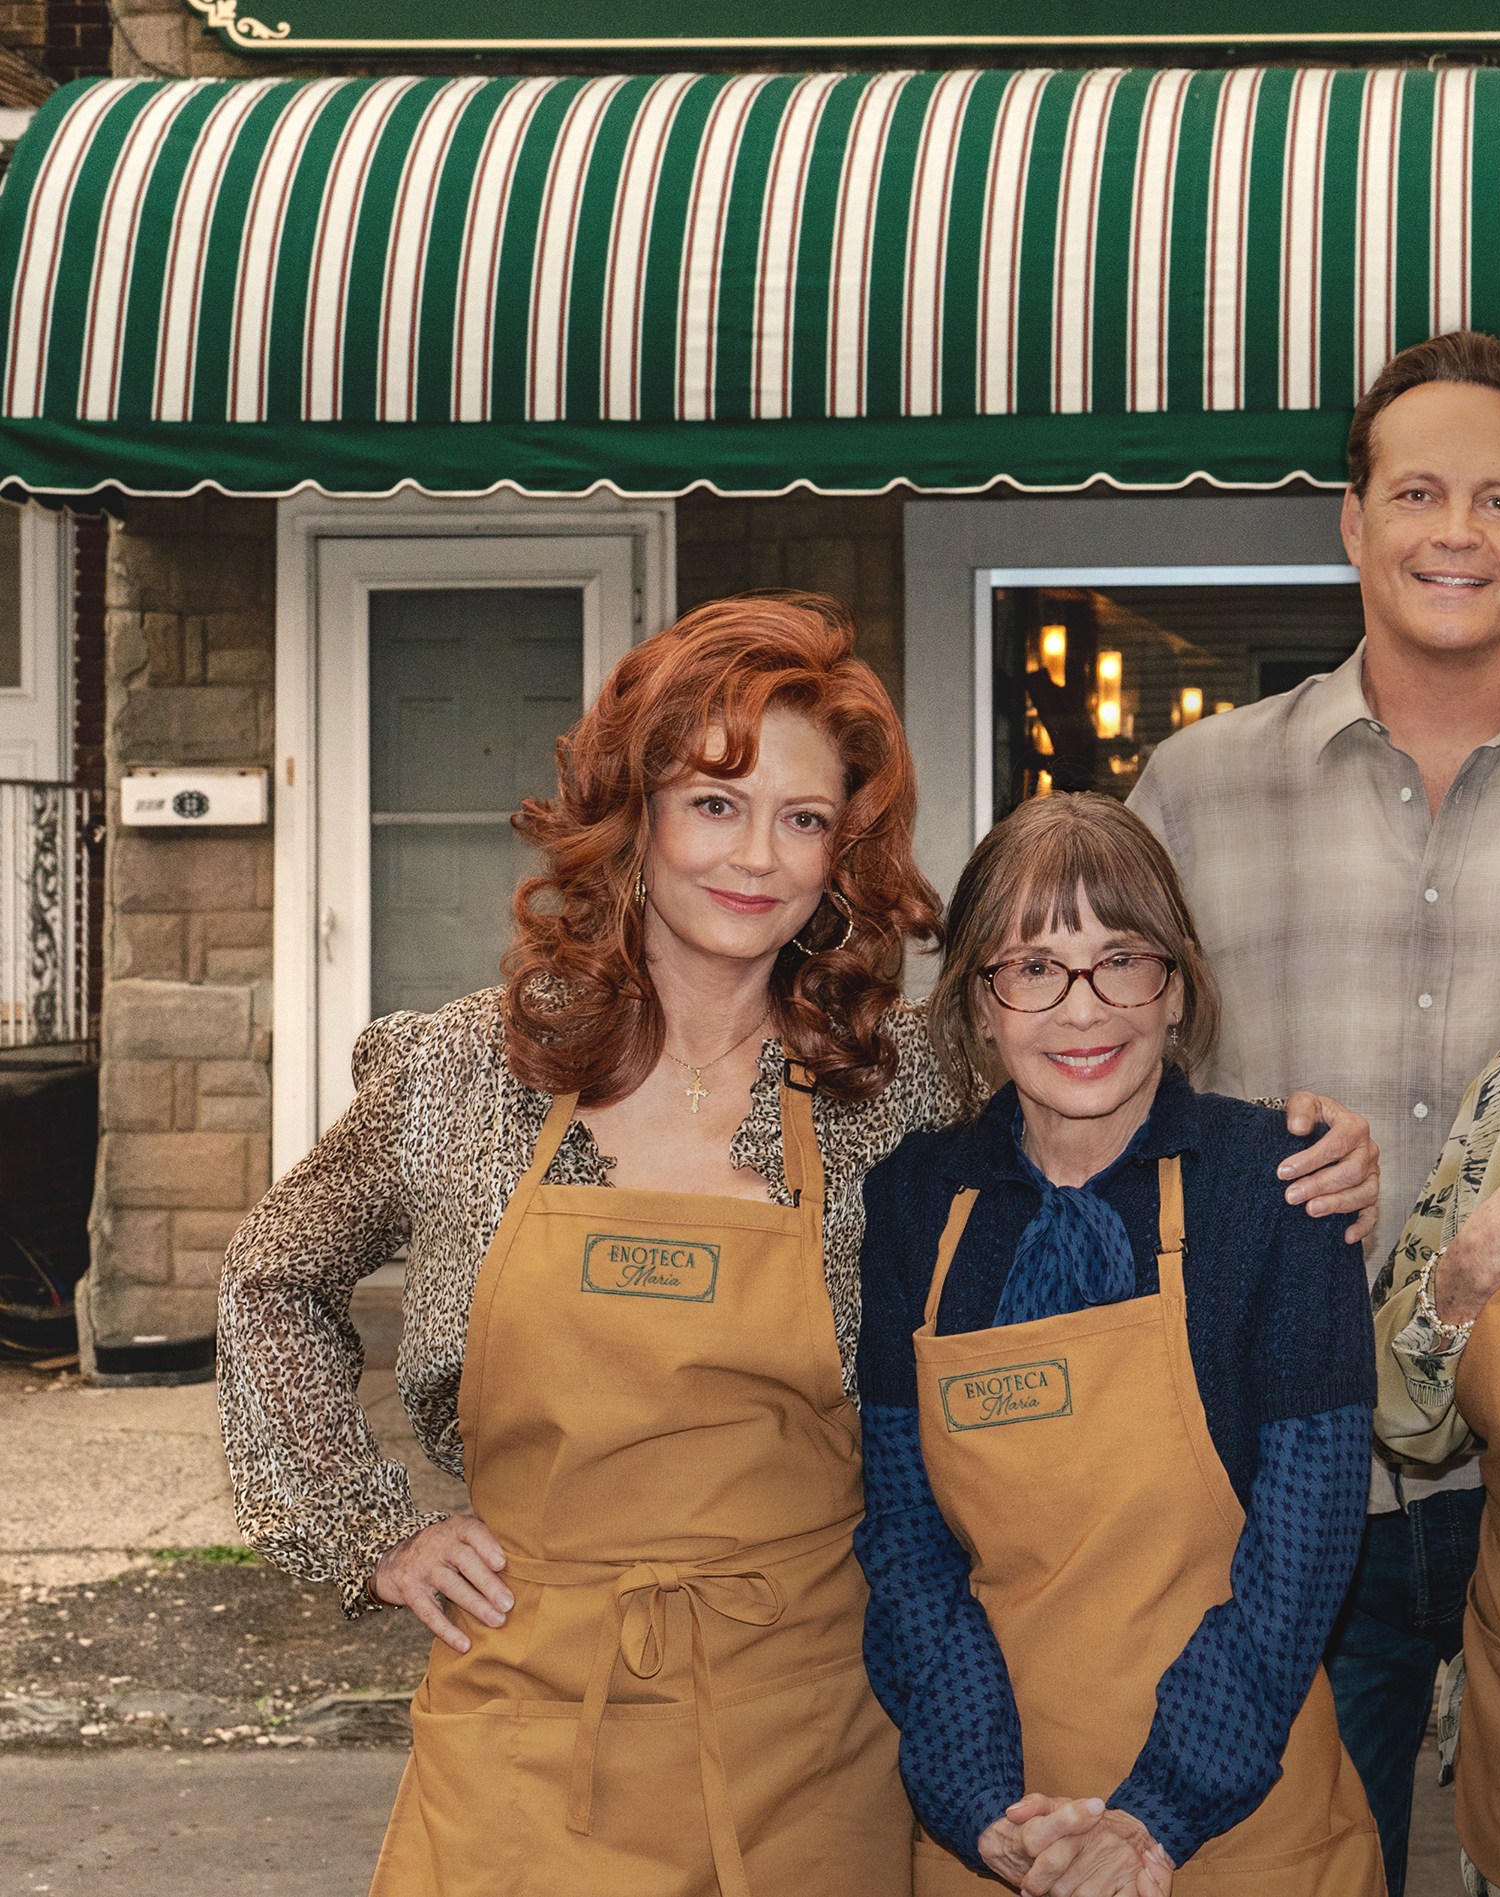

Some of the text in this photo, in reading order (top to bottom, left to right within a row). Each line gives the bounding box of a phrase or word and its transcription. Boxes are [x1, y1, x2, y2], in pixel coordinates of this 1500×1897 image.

[609, 1245, 695, 1269] ENOTECA
[616, 1265, 681, 1288] Maria
[964, 1371, 1048, 1399] ENOTECA
[980, 1393, 1040, 1420] Maria
